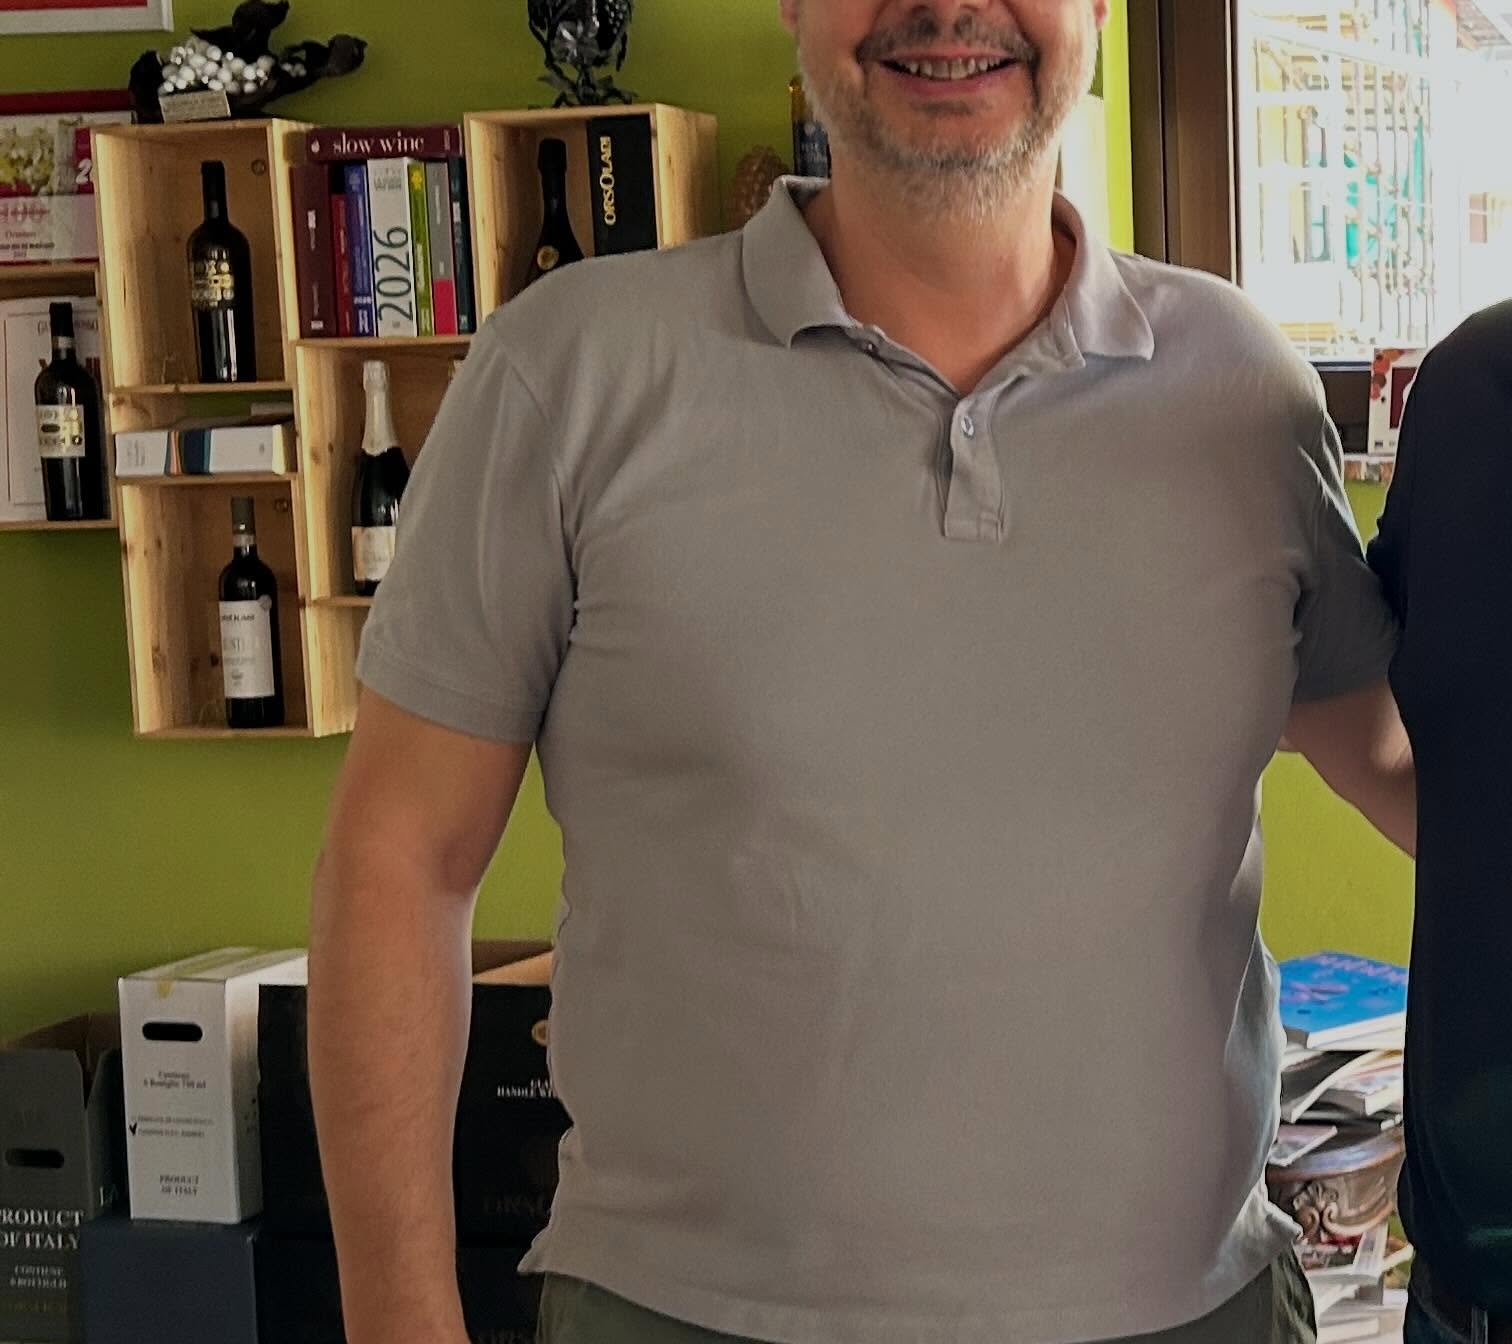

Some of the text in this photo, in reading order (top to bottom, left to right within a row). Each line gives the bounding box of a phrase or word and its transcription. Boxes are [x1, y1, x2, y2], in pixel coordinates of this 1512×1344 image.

[333, 130, 425, 155] slow wine
[373, 226, 414, 322] 2026
[0, 1208, 84, 1228] RODUCT
[24, 1231, 80, 1250] ITALY
